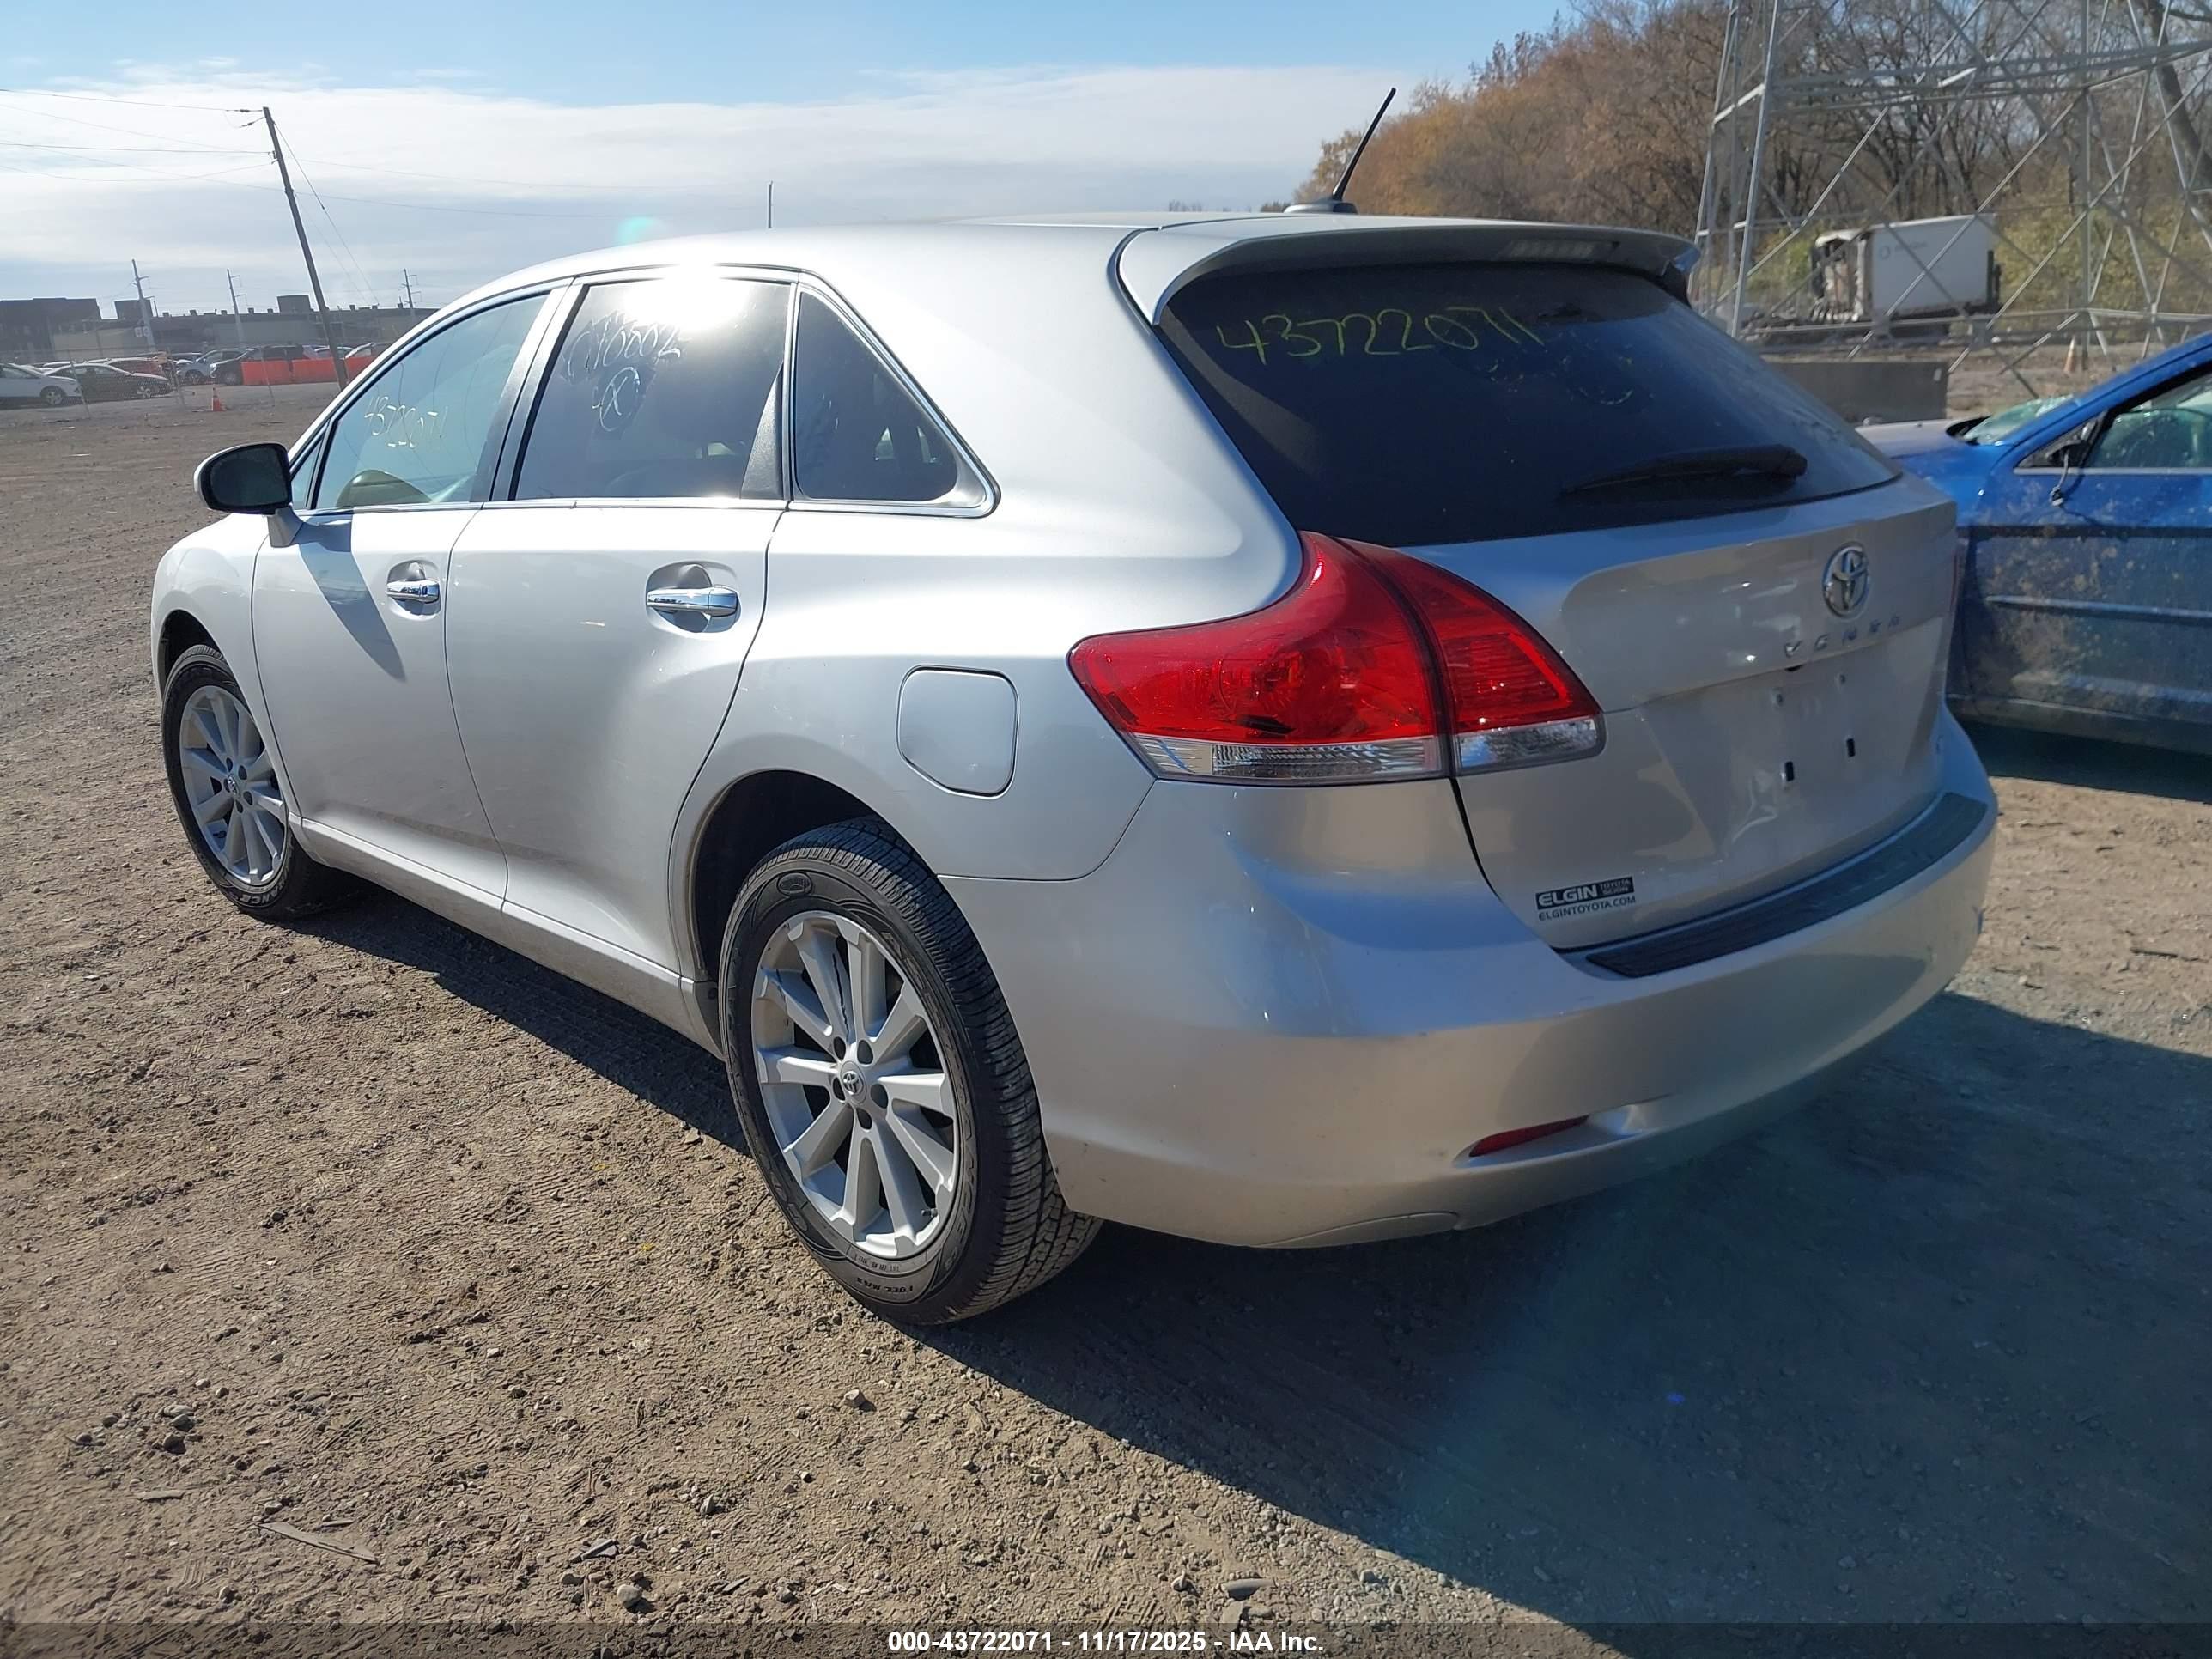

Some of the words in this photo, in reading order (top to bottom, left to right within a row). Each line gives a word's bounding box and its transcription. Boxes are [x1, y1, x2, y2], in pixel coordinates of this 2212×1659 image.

[1216, 307, 1546, 366] 43722071
[1537, 884, 1598, 908] ELGIN
[884, 1285, 914, 1295] FUEL
